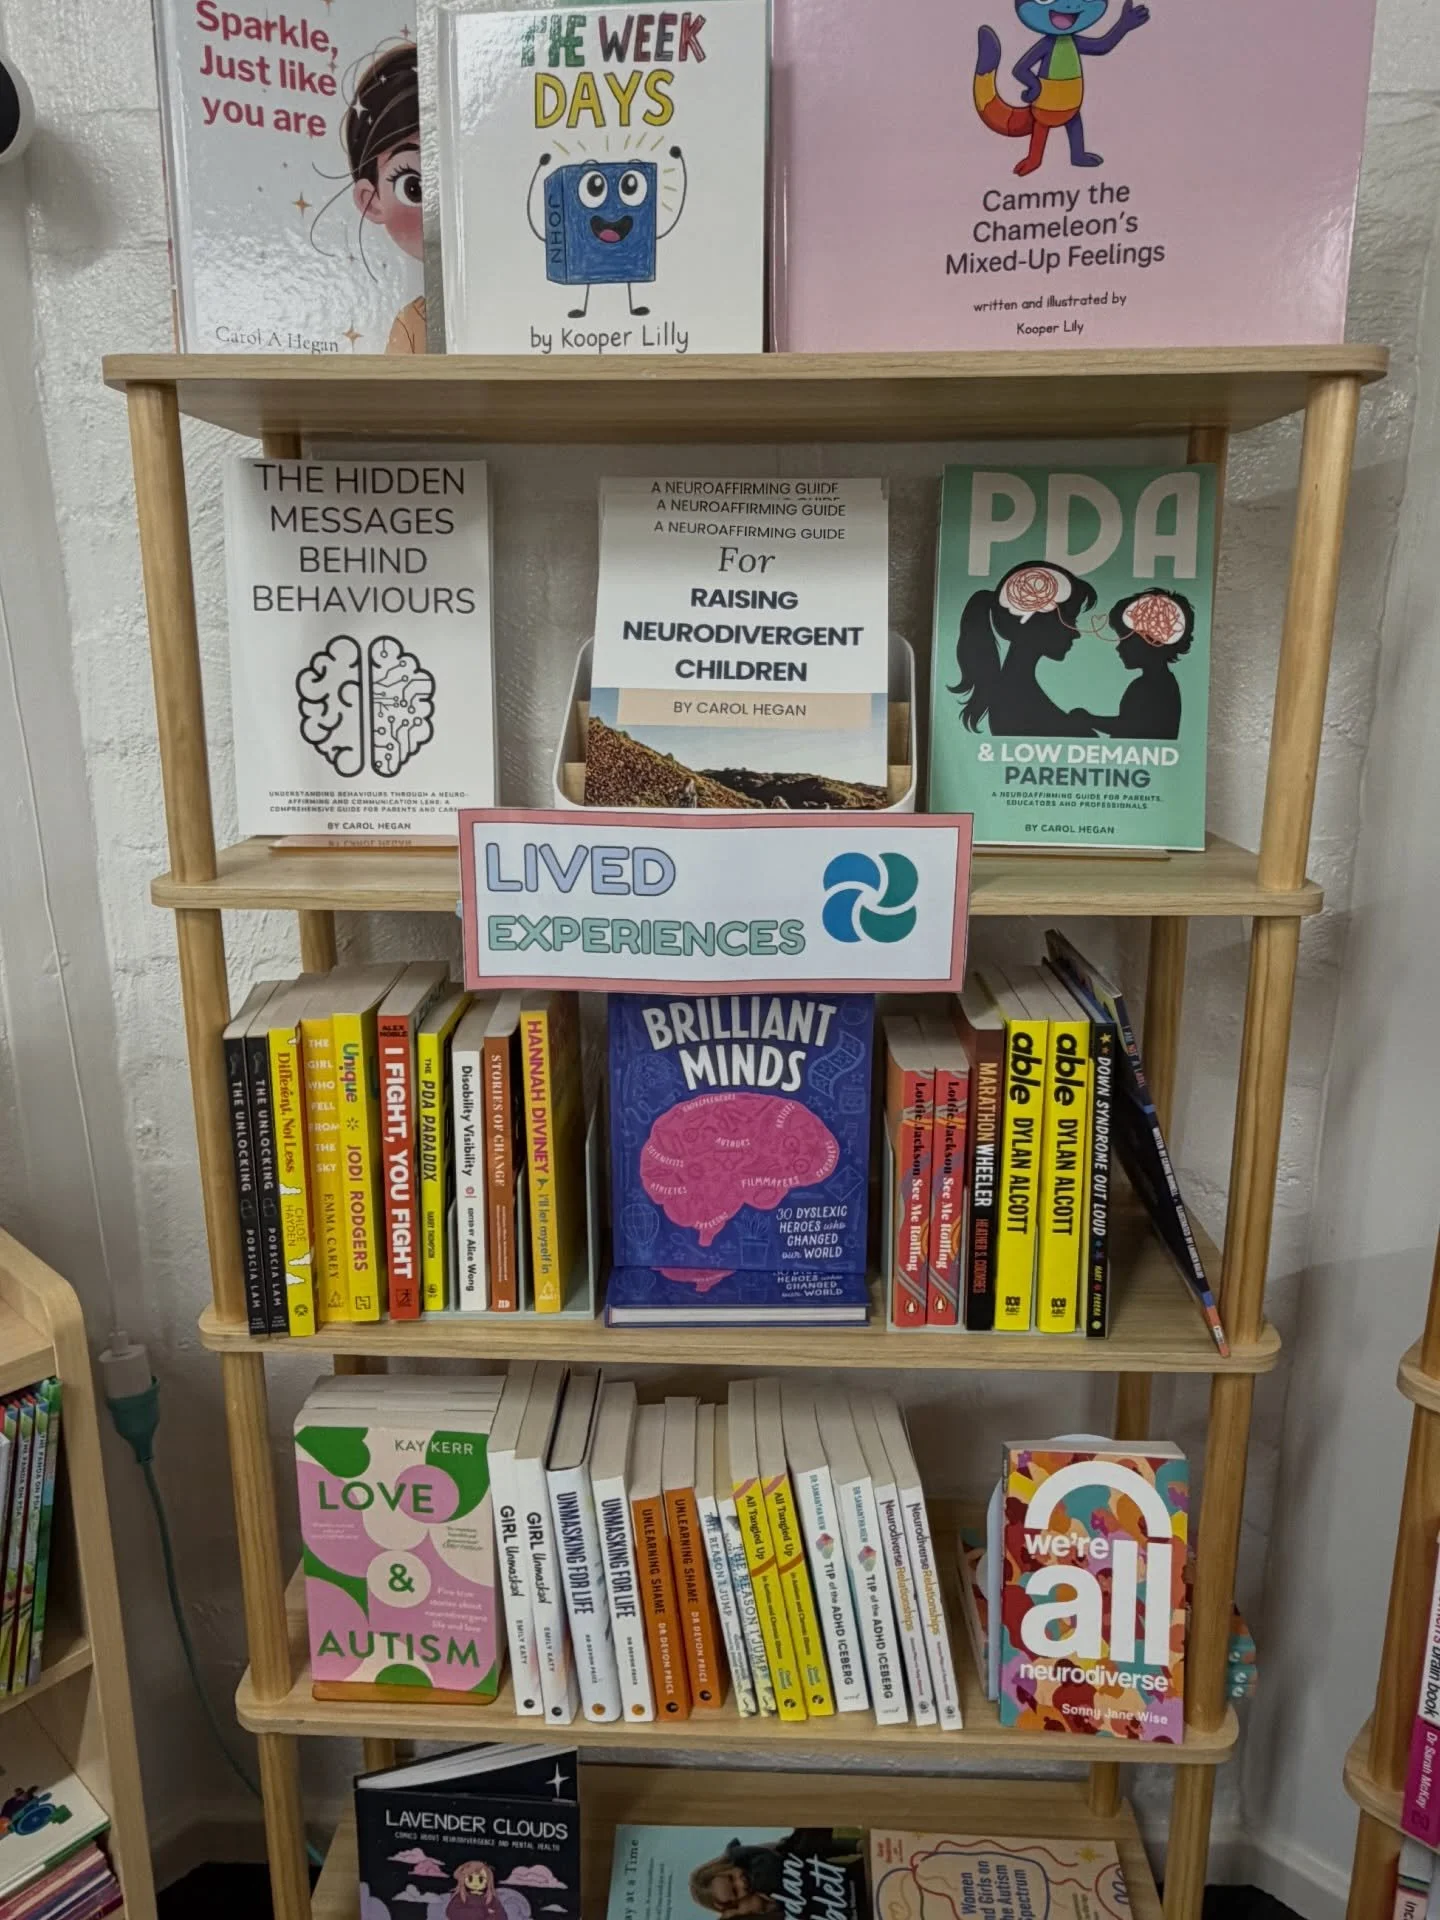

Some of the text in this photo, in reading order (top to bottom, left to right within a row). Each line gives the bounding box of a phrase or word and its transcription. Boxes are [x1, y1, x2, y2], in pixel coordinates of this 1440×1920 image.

[196, 0, 338, 60] Sparkle,
[598, 12, 707, 63] WEEK
[200, 45, 338, 97] Just like
[534, 69, 675, 129] DAYS
[202, 96, 327, 137] you are
[982, 182, 1131, 213] Cammy the
[548, 200, 564, 265] JOHN
[972, 211, 1138, 244] Chameleon's
[945, 242, 1166, 276] Mixed-Up Feelings
[973, 290, 1128, 313] written and illustrated by
[530, 321, 689, 354] by Kooper Lilly
[1016, 322, 1060, 337] Kooper
[254, 463, 465, 495] THE HIDDEN
[651, 481, 840, 496] A NEUROAFFIRMING GUIDE
[271, 505, 455, 535] MESSAGES
[656, 499, 847, 517] A NEUROAFFIRMING GUIDE
[654, 521, 846, 540] A NEUROAFFIRMING GUIDE
[968, 471, 1201, 580] PDA
[300, 546, 428, 574] BEHIND
[718, 546, 776, 574] For
[253, 585, 476, 614] BEHAVIOURS
[690, 588, 799, 610] RAISING
[622, 620, 865, 647] NEURODIVERGENT
[675, 659, 808, 682] CHILDREN
[673, 701, 807, 717] BY CAROL HEGAN
[976, 743, 1180, 767] & LOW DEMAND
[1004, 766, 1152, 789] PARENTING
[327, 822, 411, 831] BY CAROL HEGAN
[1025, 823, 1116, 835] BY CAROL HEGAN
[485, 842, 677, 897] LIVED
[487, 914, 807, 957] EXPERIENCES
[641, 996, 838, 1051] BRILLIANT
[339, 1043, 360, 1103] Unique
[679, 1044, 807, 1092] MINDS
[277, 1052, 297, 1174] Different, Not Less
[527, 1020, 550, 1174] HANNAH DIVINEY
[232, 1081, 252, 1192] THE UNLOCKING
[421, 1058, 438, 1182] THE PDA PARADOX
[459, 1065, 477, 1177] Disability Visibility
[491, 1054, 506, 1187] STORIES OF CHANGE
[973, 1063, 998, 1207] MARATHON WHEELER
[1007, 1032, 1042, 1235] able DYLAN ALCOTT
[1092, 1056, 1111, 1236] DOWN SYNDROME OUT LOUD
[384, 1047, 413, 1280] I FIGHT, YOU FIGHT
[741, 1176, 801, 1189] FILMMAKERS
[347, 1145, 369, 1272] JODI RODGERS
[776, 1206, 848, 1220] 30 DYSLEXIC
[324, 1193, 340, 1280] EMMA CAREY
[780, 1220, 821, 1234] HEROES
[787, 1233, 839, 1247] CHANGED
[804, 1247, 843, 1260] WORLD
[394, 1439, 475, 1455] KAY KERR
[318, 1480, 434, 1514] LOVE
[746, 1495, 765, 1560] All Tangled Up
[556, 1491, 595, 1615] UNMASKING FOR LIFE
[642, 1508, 666, 1615] UNLEARNING SHAME
[1024, 1533, 1110, 1560] we're
[388, 1563, 416, 1593] &
[823, 1562, 835, 1579] TIP
[880, 1499, 915, 1632] Neurodiverse Relationships
[828, 1580, 837, 1590] of
[829, 1591, 839, 1605] the
[1020, 1540, 1173, 1667] all
[831, 1605, 847, 1638] ADHD
[317, 1630, 480, 1668] AUTISM
[515, 1619, 529, 1665] EMILY KATY
[837, 1639, 854, 1686] ICEBERG
[1019, 1663, 1170, 1693] neurodiverse
[1061, 1703, 1169, 1726] Sonny Jane Wise
[1415, 1731, 1439, 1809] Dr Sarah McKay
[386, 1809, 569, 1841] LAVENDER CLOUDS
[395, 1832, 418, 1841] COMICS
[420, 1834, 440, 1842] ABOUT
[442, 1835, 495, 1848] NEURODIVERGENCE
[511, 1840, 534, 1850] MENTAL
[537, 1843, 561, 1852] HEALTH
[624, 1838, 640, 1874] Time
[626, 1888, 636, 1904] at
[961, 1872, 977, 1915] Women
[976, 1860, 995, 1905] Girls on
[994, 1864, 1013, 1906] Autism
